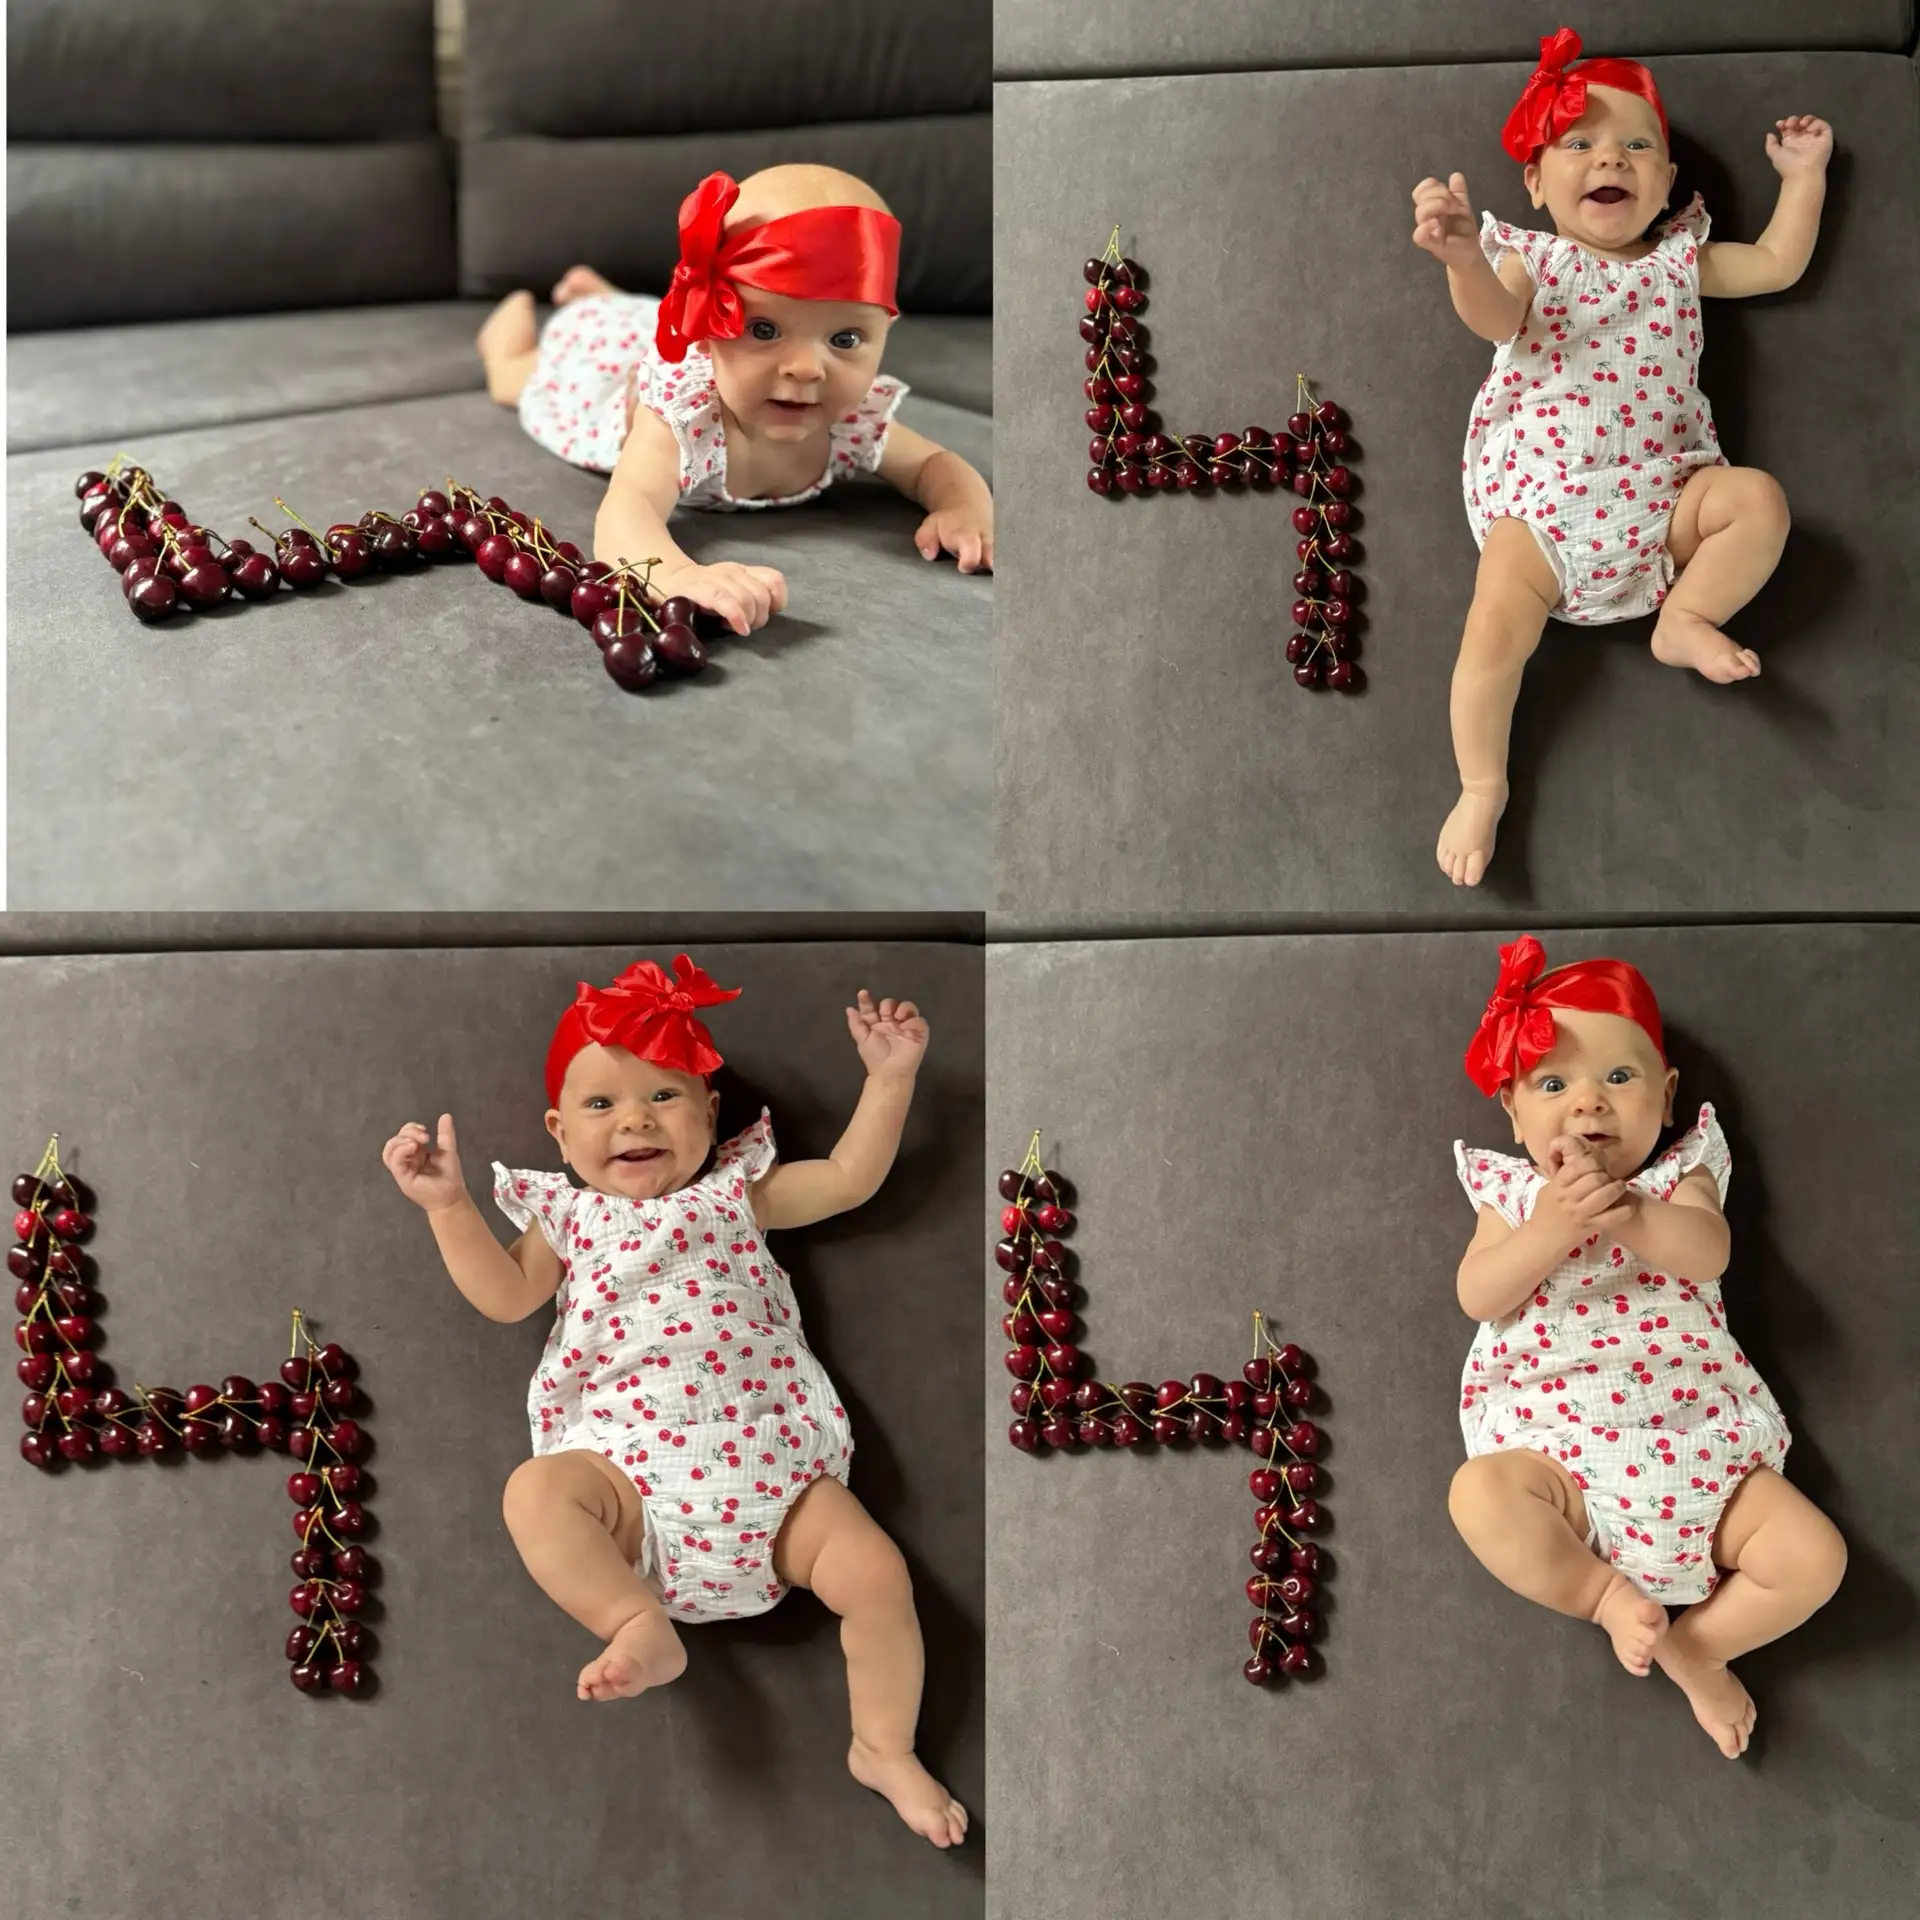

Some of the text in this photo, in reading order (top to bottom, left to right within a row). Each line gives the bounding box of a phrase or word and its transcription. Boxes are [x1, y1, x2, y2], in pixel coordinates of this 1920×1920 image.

[1080, 225, 1353, 692] 4
[8, 1133, 366, 1696] 4
[995, 1130, 1322, 1686] 4
